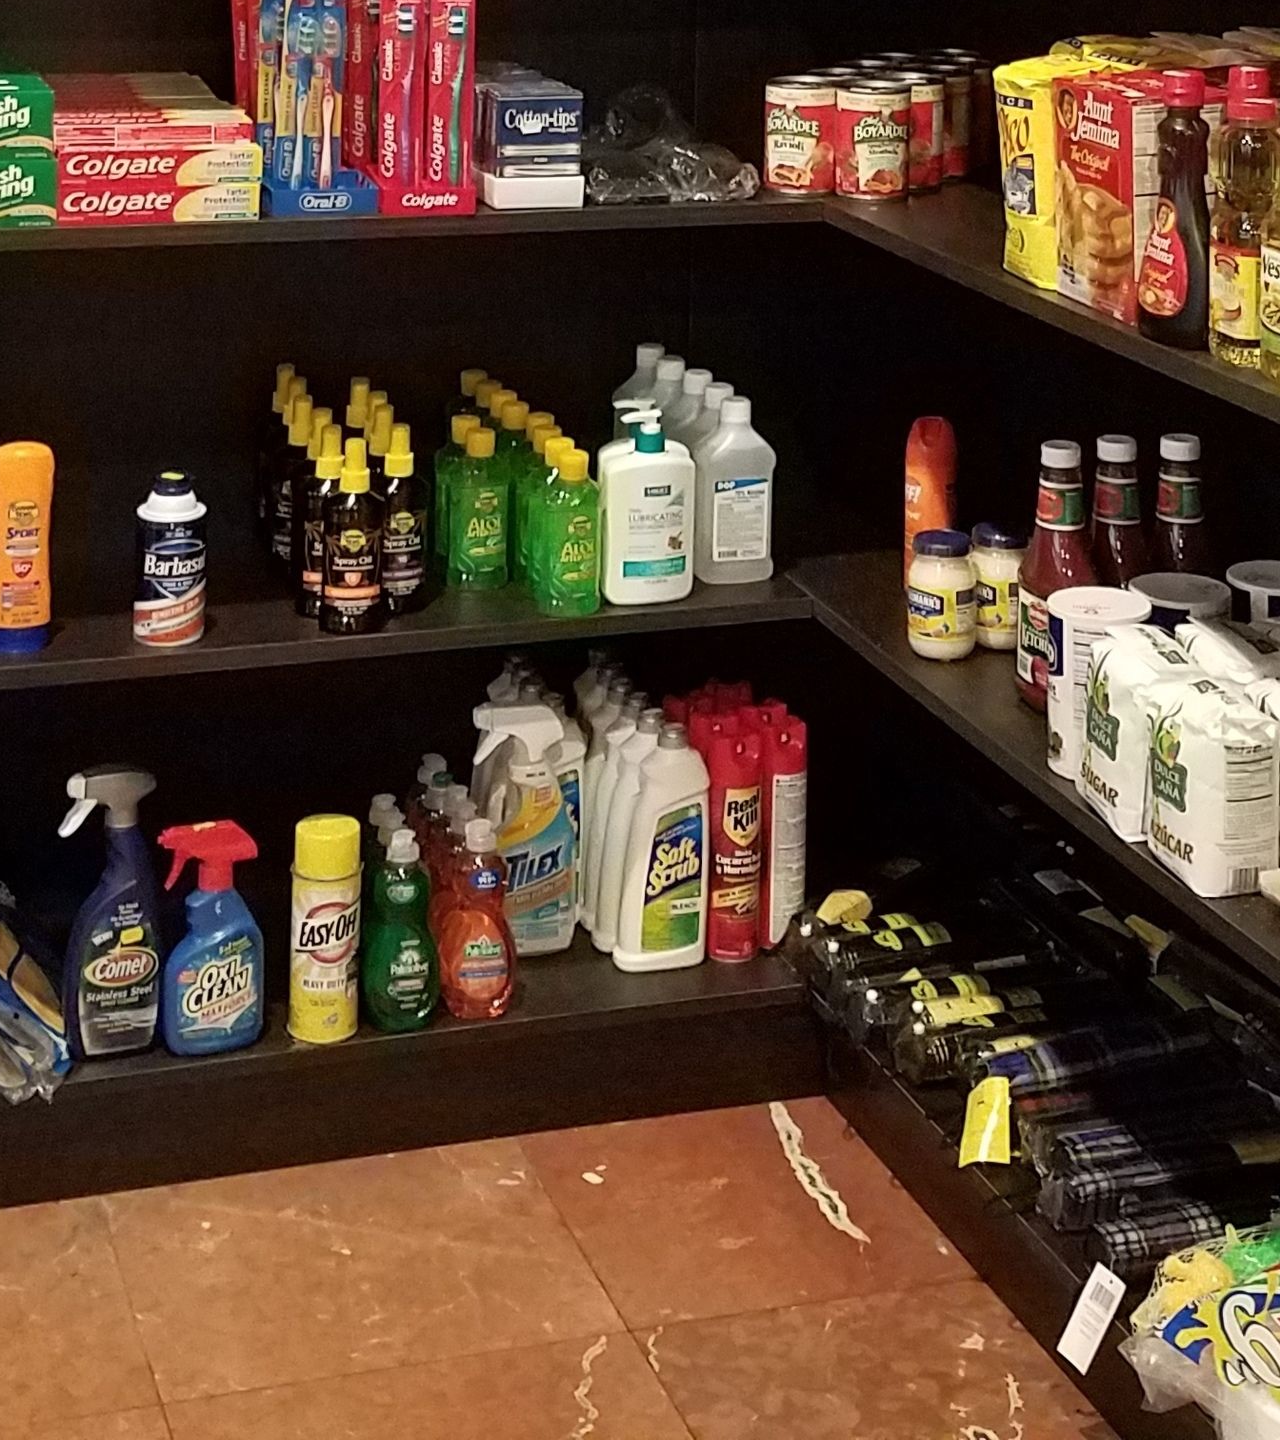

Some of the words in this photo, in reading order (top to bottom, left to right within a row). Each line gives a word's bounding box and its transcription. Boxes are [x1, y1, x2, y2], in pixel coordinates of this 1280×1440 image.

[382, 38, 394, 82] Classic
[431, 41, 443, 85] Classic
[1083, 91, 1114, 124] Aunt
[352, 94, 366, 158] Colgate
[767, 116, 820, 136] BOYARDEE
[1070, 111, 1121, 149] Jemima
[228, 151, 254, 160] Tartar
[381, 112, 396, 178] Colgate
[429, 114, 444, 182] Colgate
[65, 154, 176, 180] Colgate
[207, 160, 253, 169] Protection
[1080, 148, 1110, 172] Original
[62, 190, 173, 217] Colgate
[202, 195, 250, 206] Protection
[225, 187, 251, 196] Tartar
[303, 196, 348, 209] Oral-B
[401, 193, 459, 208] Colgate
[629, 511, 683, 523] LUBRICATING
[6, 526, 41, 540] SPORT
[383, 538, 408, 549] Spray
[408, 535, 421, 546] Oil
[144, 551, 206, 577] Barbasol
[333, 556, 357, 567] Spray
[358, 555, 373, 565] Oil
[1080, 761, 1120, 809] SUGAR
[1154, 758, 1181, 786] DULCE
[727, 788, 760, 818] Real
[733, 807, 758, 833] Kill
[654, 836, 697, 869] Soft
[1151, 818, 1195, 865] AZÚCAR
[646, 855, 701, 897] Scrub
[299, 908, 359, 948] EASY-OFF
[94, 956, 148, 981] Comet
[200, 960, 238, 990] OXI
[86, 989, 129, 1003] Stainless
[130, 983, 154, 996] Steel
[187, 969, 251, 1014] CLEAN
[303, 979, 325, 990] HEAVY
[325, 978, 346, 989] DUTY
